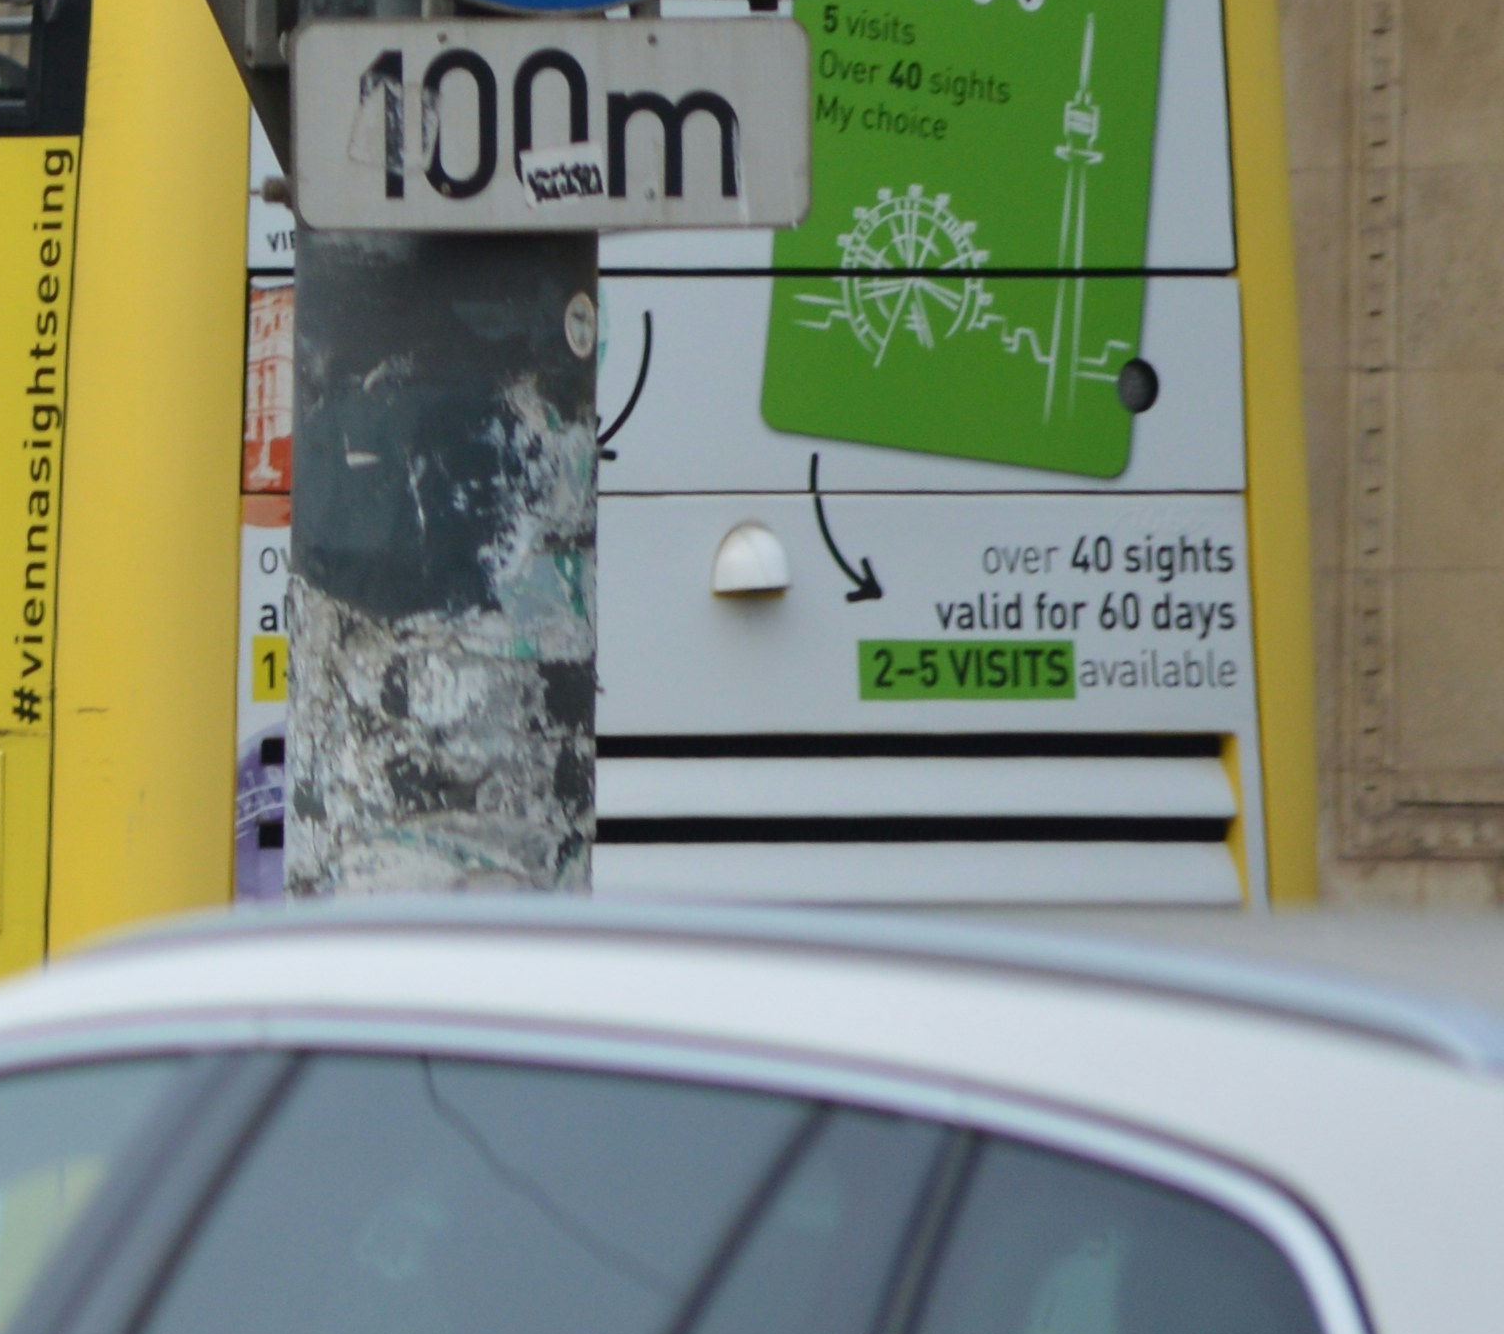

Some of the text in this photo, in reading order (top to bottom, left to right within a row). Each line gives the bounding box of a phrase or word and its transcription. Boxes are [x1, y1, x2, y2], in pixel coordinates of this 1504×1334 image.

[822, 4, 916, 46] 5 visits
[819, 48, 1012, 107] Over 40 sights
[815, 92, 948, 141] My choice
[12, 145, 74, 725] #viennasightseeing
[982, 535, 1235, 584] over 40 sights
[936, 591, 1238, 641] valid for 60 days
[948, 647, 1071, 688] VISITS
[1079, 648, 1239, 689] available
